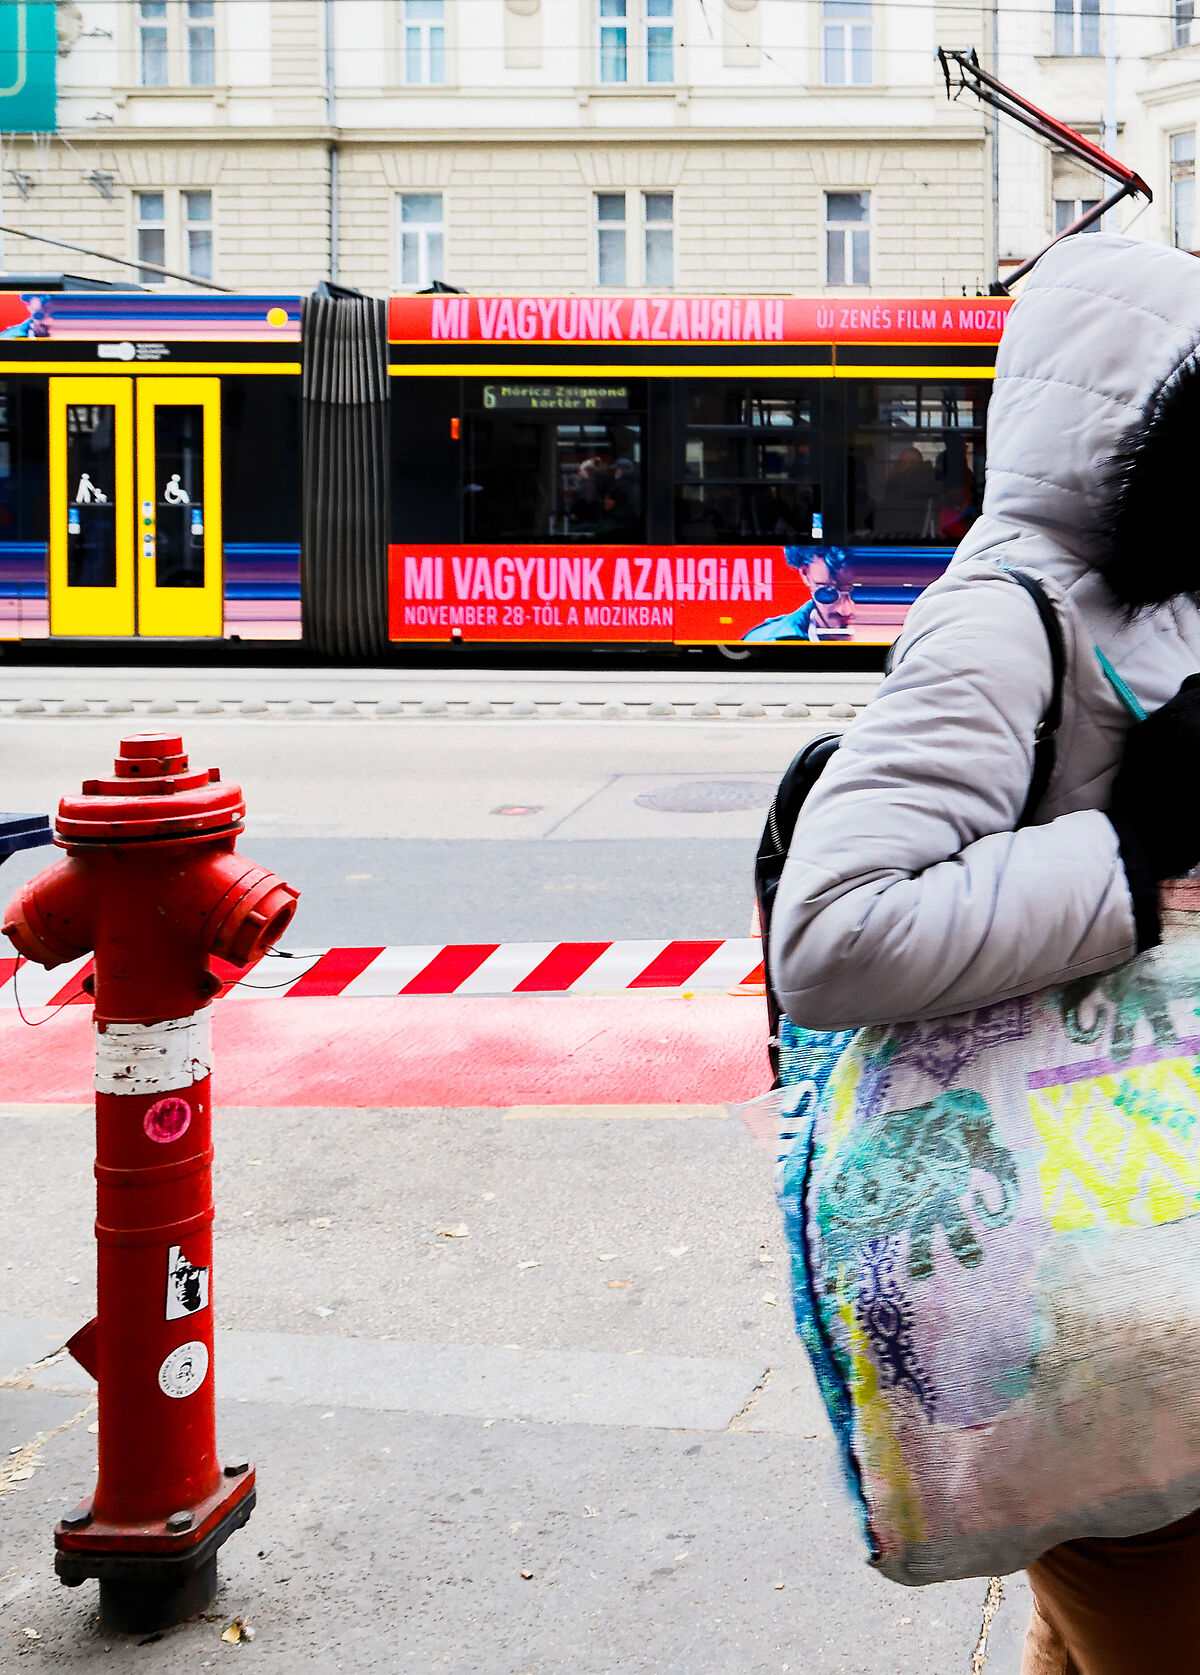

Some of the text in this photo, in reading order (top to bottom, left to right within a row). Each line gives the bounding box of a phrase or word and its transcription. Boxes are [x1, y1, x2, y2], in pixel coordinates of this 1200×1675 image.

[431, 298, 470, 340] MI
[477, 298, 624, 341] VAGYUNK
[816, 304, 1007, 330] ÚJ ZENÉS FILM A MOZI
[483, 386, 497, 409] 6
[404, 557, 443, 600] MI
[451, 557, 605, 602] VAGYUNK
[404, 603, 674, 627] NOVEMBER 28-TÓL A MOZIKBAN
